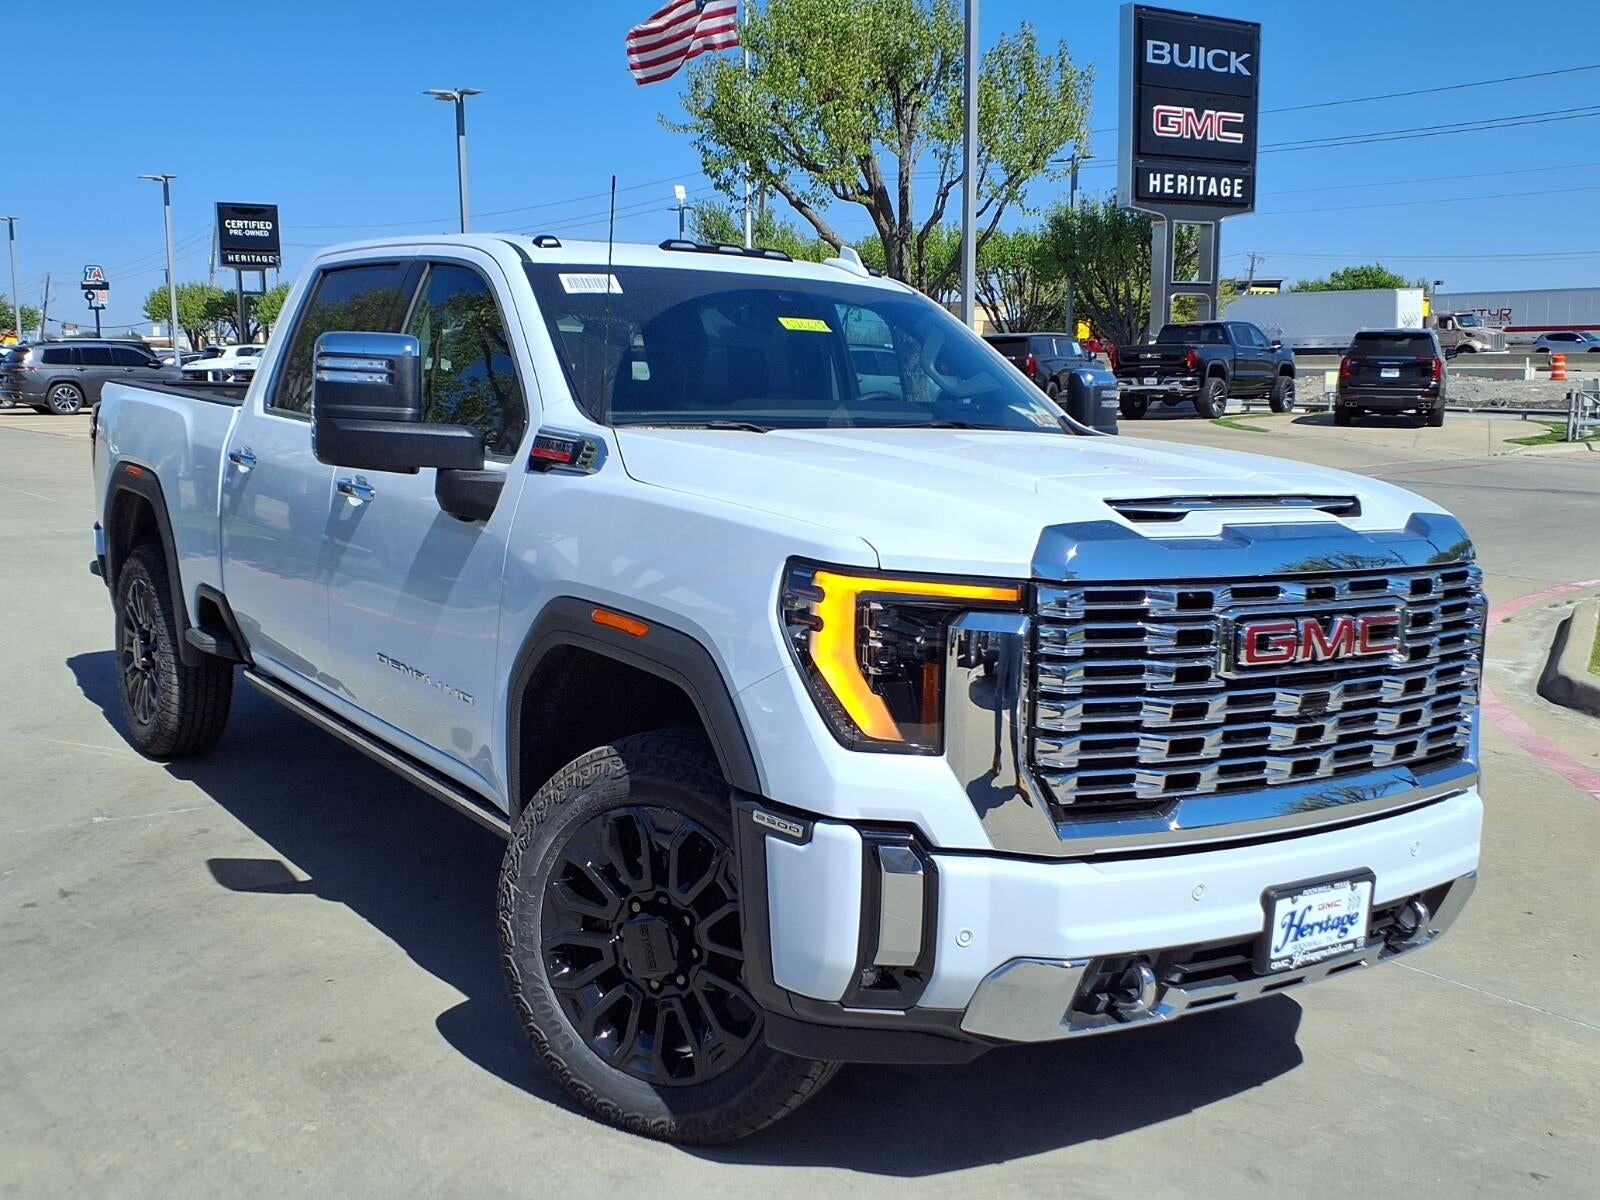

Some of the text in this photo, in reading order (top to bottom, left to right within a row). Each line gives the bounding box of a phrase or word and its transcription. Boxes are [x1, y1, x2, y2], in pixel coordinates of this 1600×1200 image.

[1146, 39, 1252, 76] BUICK
[1153, 104, 1245, 144] GMC
[1149, 172, 1243, 198] HERITAGE
[225, 219, 273, 230] CERTIFIED
[229, 229, 270, 237] PRE-OWNED
[227, 254, 275, 263] HERITAGE
[84, 265, 105, 281] TA
[1241, 613, 1399, 665] GMC
[755, 813, 800, 834] 2500
[1317, 899, 1342, 911] GMC
[1274, 905, 1359, 953] Heritage
